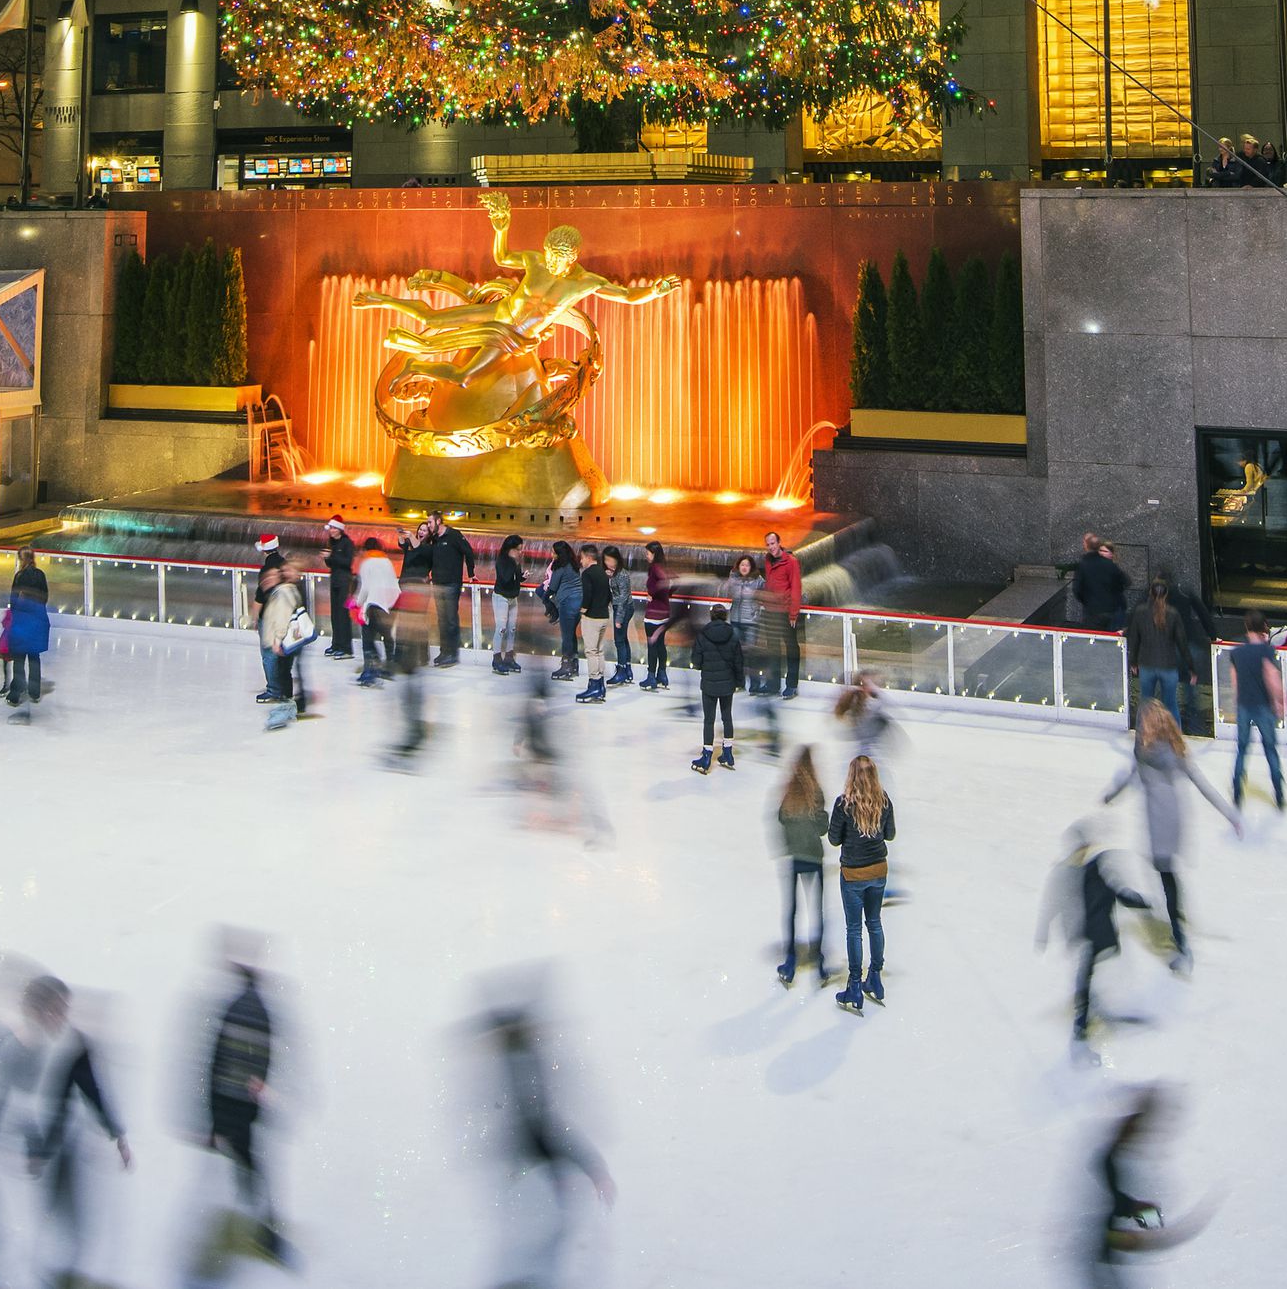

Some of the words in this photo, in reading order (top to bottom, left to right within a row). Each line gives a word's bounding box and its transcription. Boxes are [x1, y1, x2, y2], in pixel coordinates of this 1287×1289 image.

[264, 135, 278, 143] NBC
[313, 134, 330, 142] Store
[358, 191, 451, 199] TEACHER
[523, 189, 591, 198] EVERY
[617, 188, 656, 197] ART
[820, 186, 861, 194] THE
[893, 185, 953, 194] FIRE
[432, 200, 452, 209] TO
[633, 198, 705, 207] MEANS
[734, 198, 757, 206] TO
[784, 197, 880, 206] MIGHTY
[912, 196, 972, 205] ENDS
